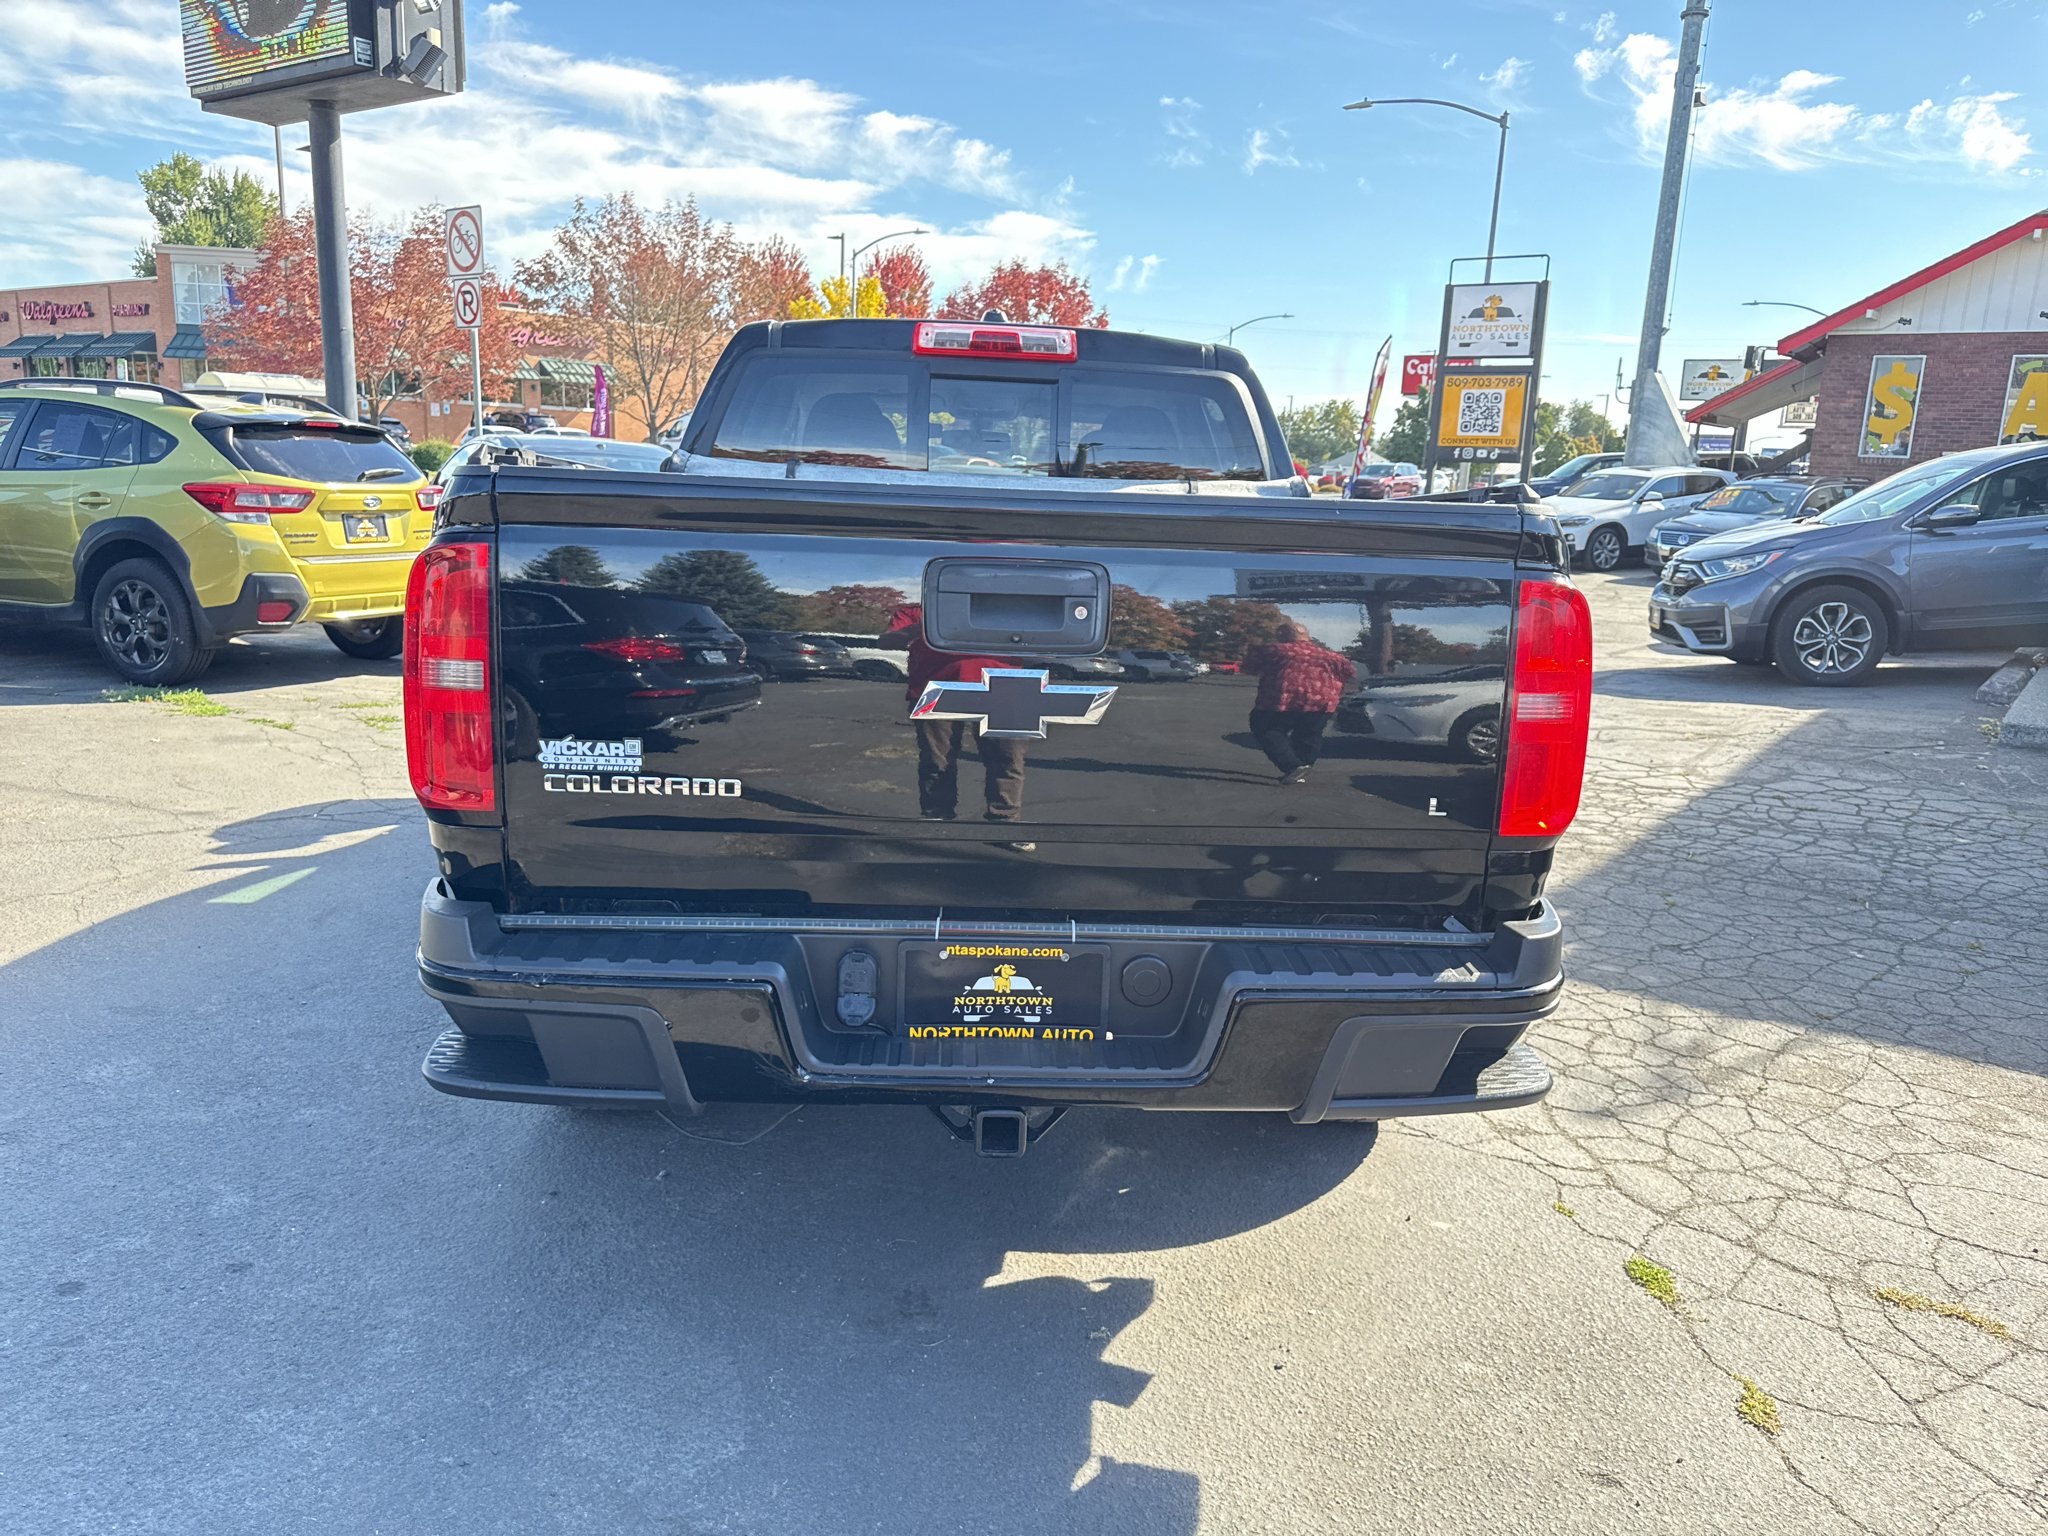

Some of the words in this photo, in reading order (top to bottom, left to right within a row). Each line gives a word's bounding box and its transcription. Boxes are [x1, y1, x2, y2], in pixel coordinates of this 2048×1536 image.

[192, 84, 214, 95] AMERICAN
[214, 82, 223, 90] LED
[223, 76, 253, 89] TECHNOLOGY
[21, 301, 90, 323] Walgreens
[112, 303, 149, 317] PHARMACY
[1453, 324, 1530, 332] NORTHTOWN
[1450, 332, 1483, 341] AUTO
[1490, 332, 1529, 340] SALES
[538, 736, 624, 757] VICKAR
[542, 755, 638, 764] COMMUNITY
[543, 773, 742, 797] COLORADO
[946, 944, 1064, 958] ntaspokane.com
[953, 996, 1053, 1006] NORTHTOWN
[952, 1005, 995, 1014] AUTO
[1003, 1005, 1053, 1014] SALES
[909, 1026, 1034, 1038] NORTHTOWN
[1042, 1028, 1094, 1040] AUTO
